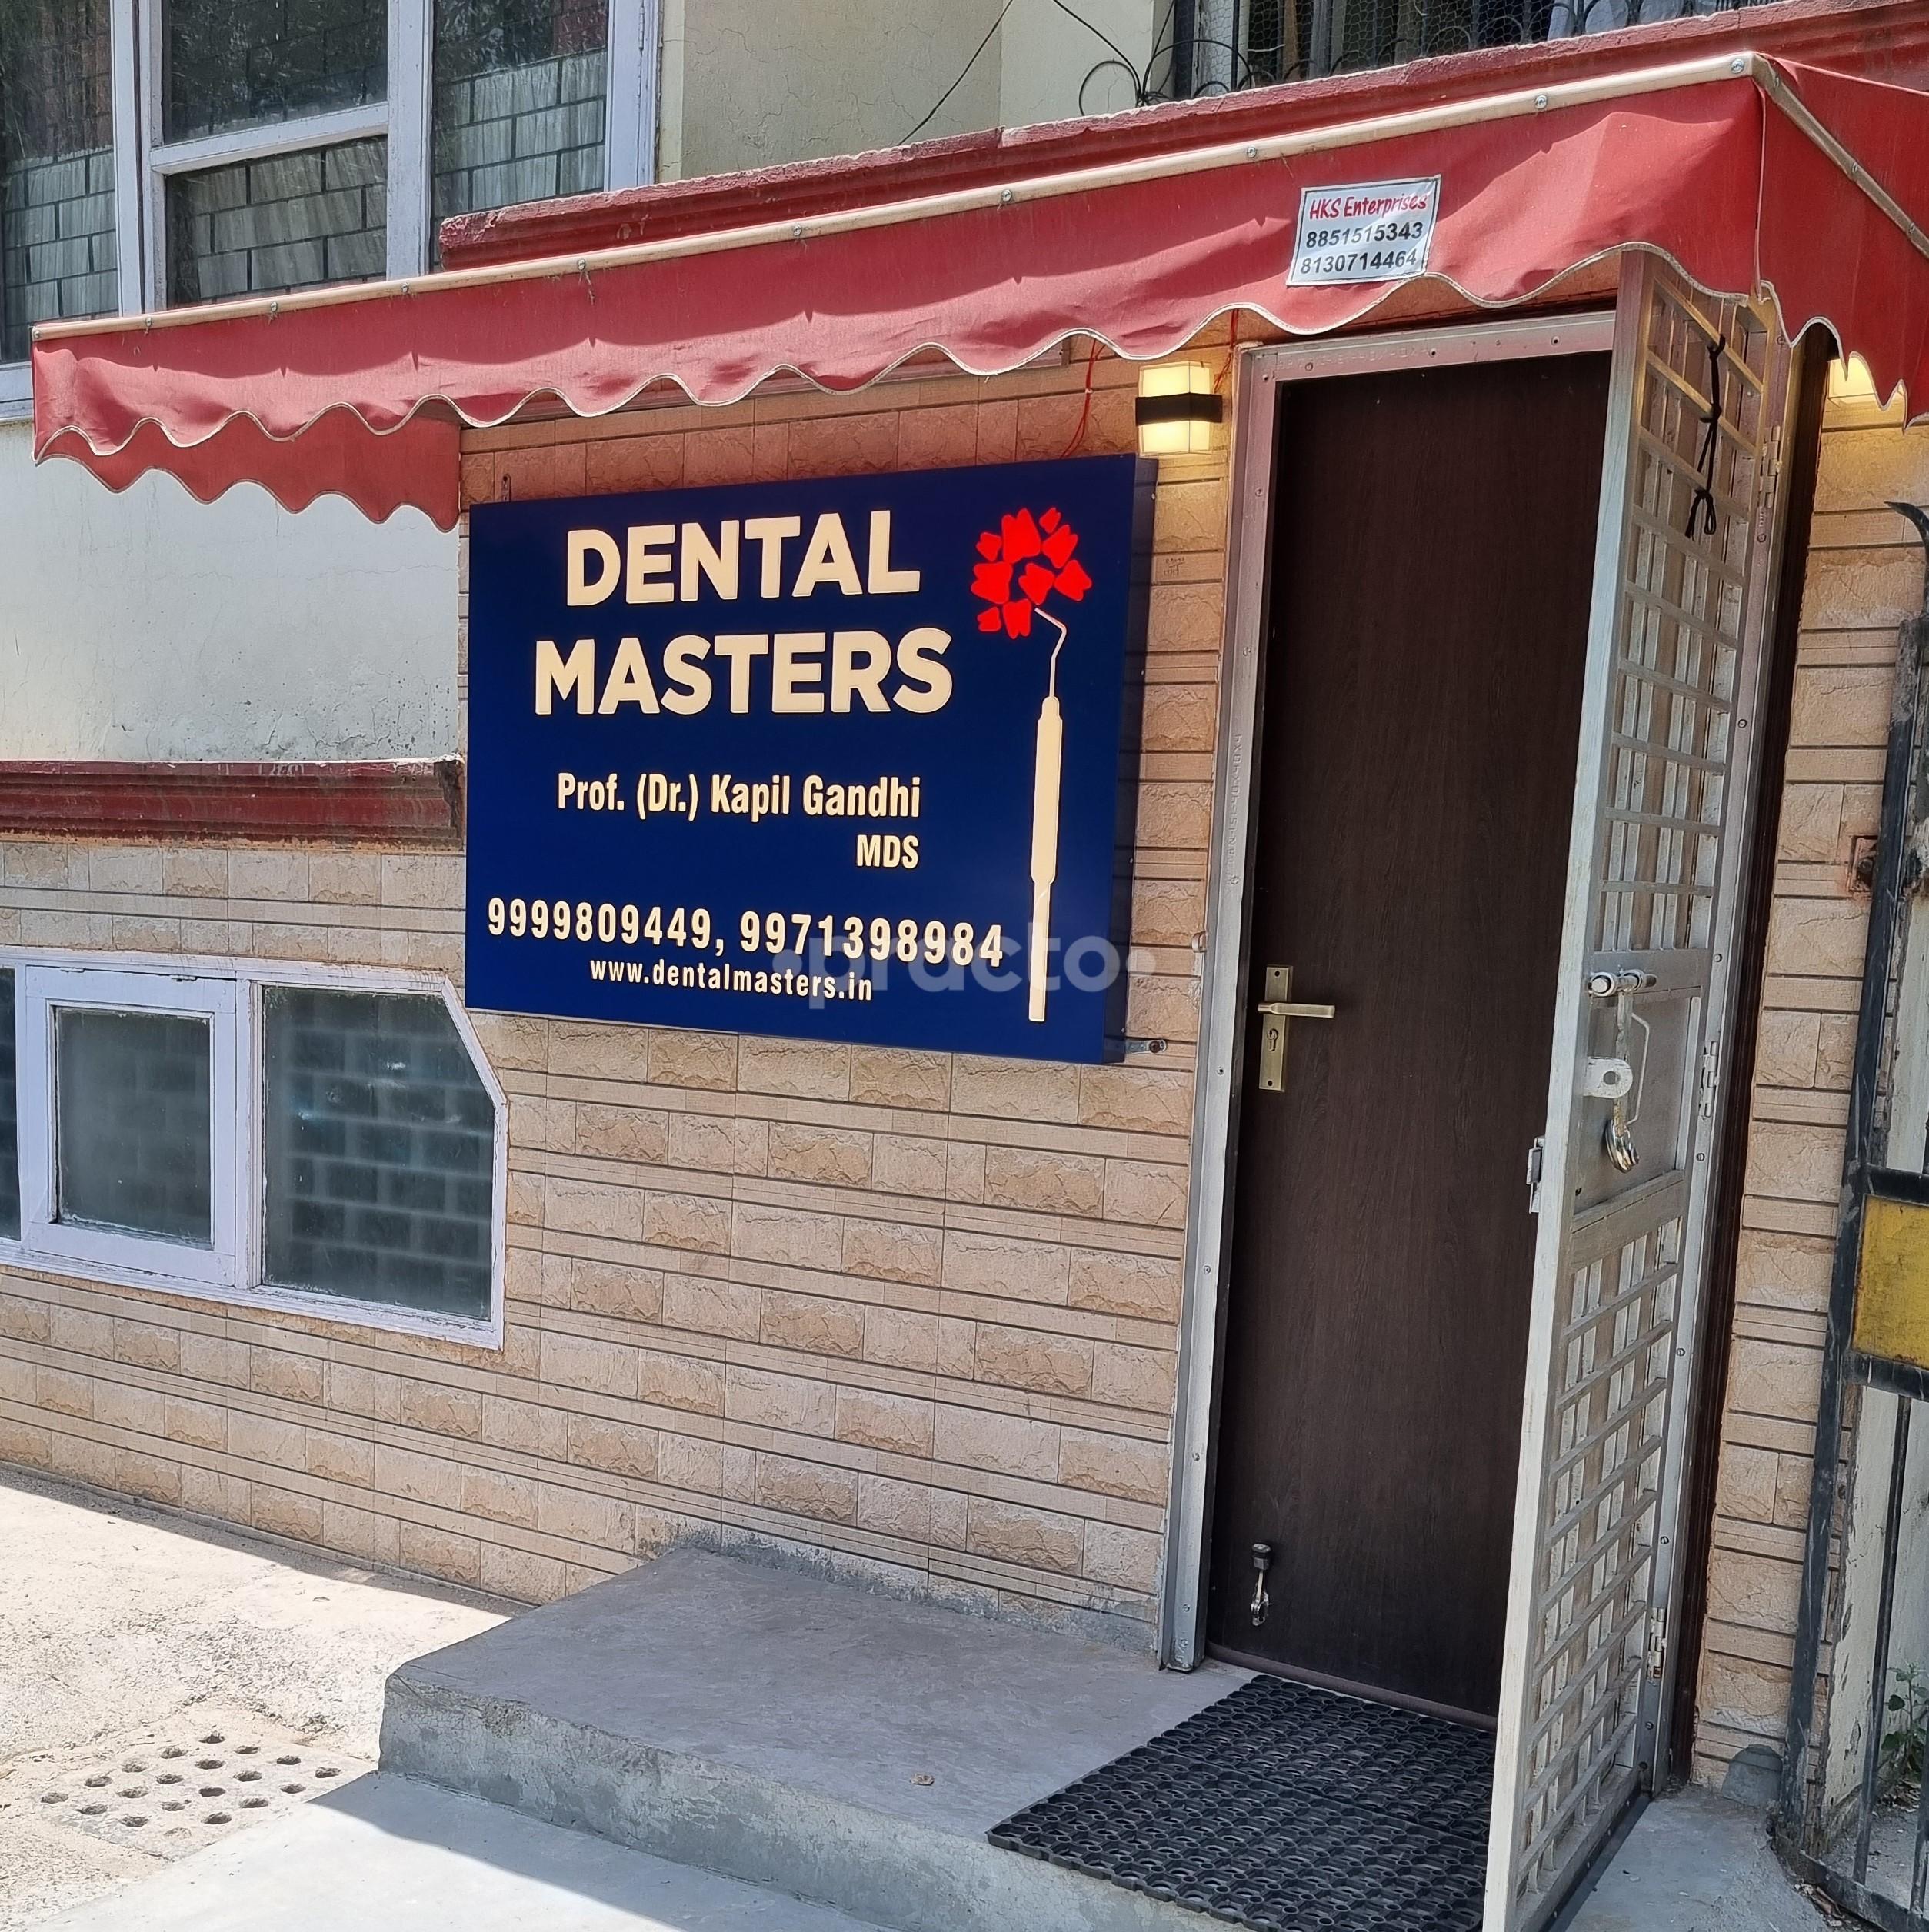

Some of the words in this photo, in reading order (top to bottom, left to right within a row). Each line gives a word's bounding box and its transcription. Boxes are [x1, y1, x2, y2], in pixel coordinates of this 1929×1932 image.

[1309, 198, 1341, 220] HKS
[1344, 192, 1428, 218] Enterprises
[1305, 222, 1424, 248] 8851515343
[1300, 248, 1417, 275] 8130714464
[566, 509, 921, 606] DENTAL
[535, 627, 954, 715] MASTERS
[558, 772, 625, 811] Prof.
[637, 773, 699, 821] (Dr.)
[711, 774, 791, 823] Kapil
[802, 774, 921, 818] Gandhi
[856, 834, 919, 870] MDS
[488, 897, 724, 957] 9999809449,
[740, 911, 1004, 968] 9971398984
[590, 958, 873, 1001] www.dentalmasters.in
